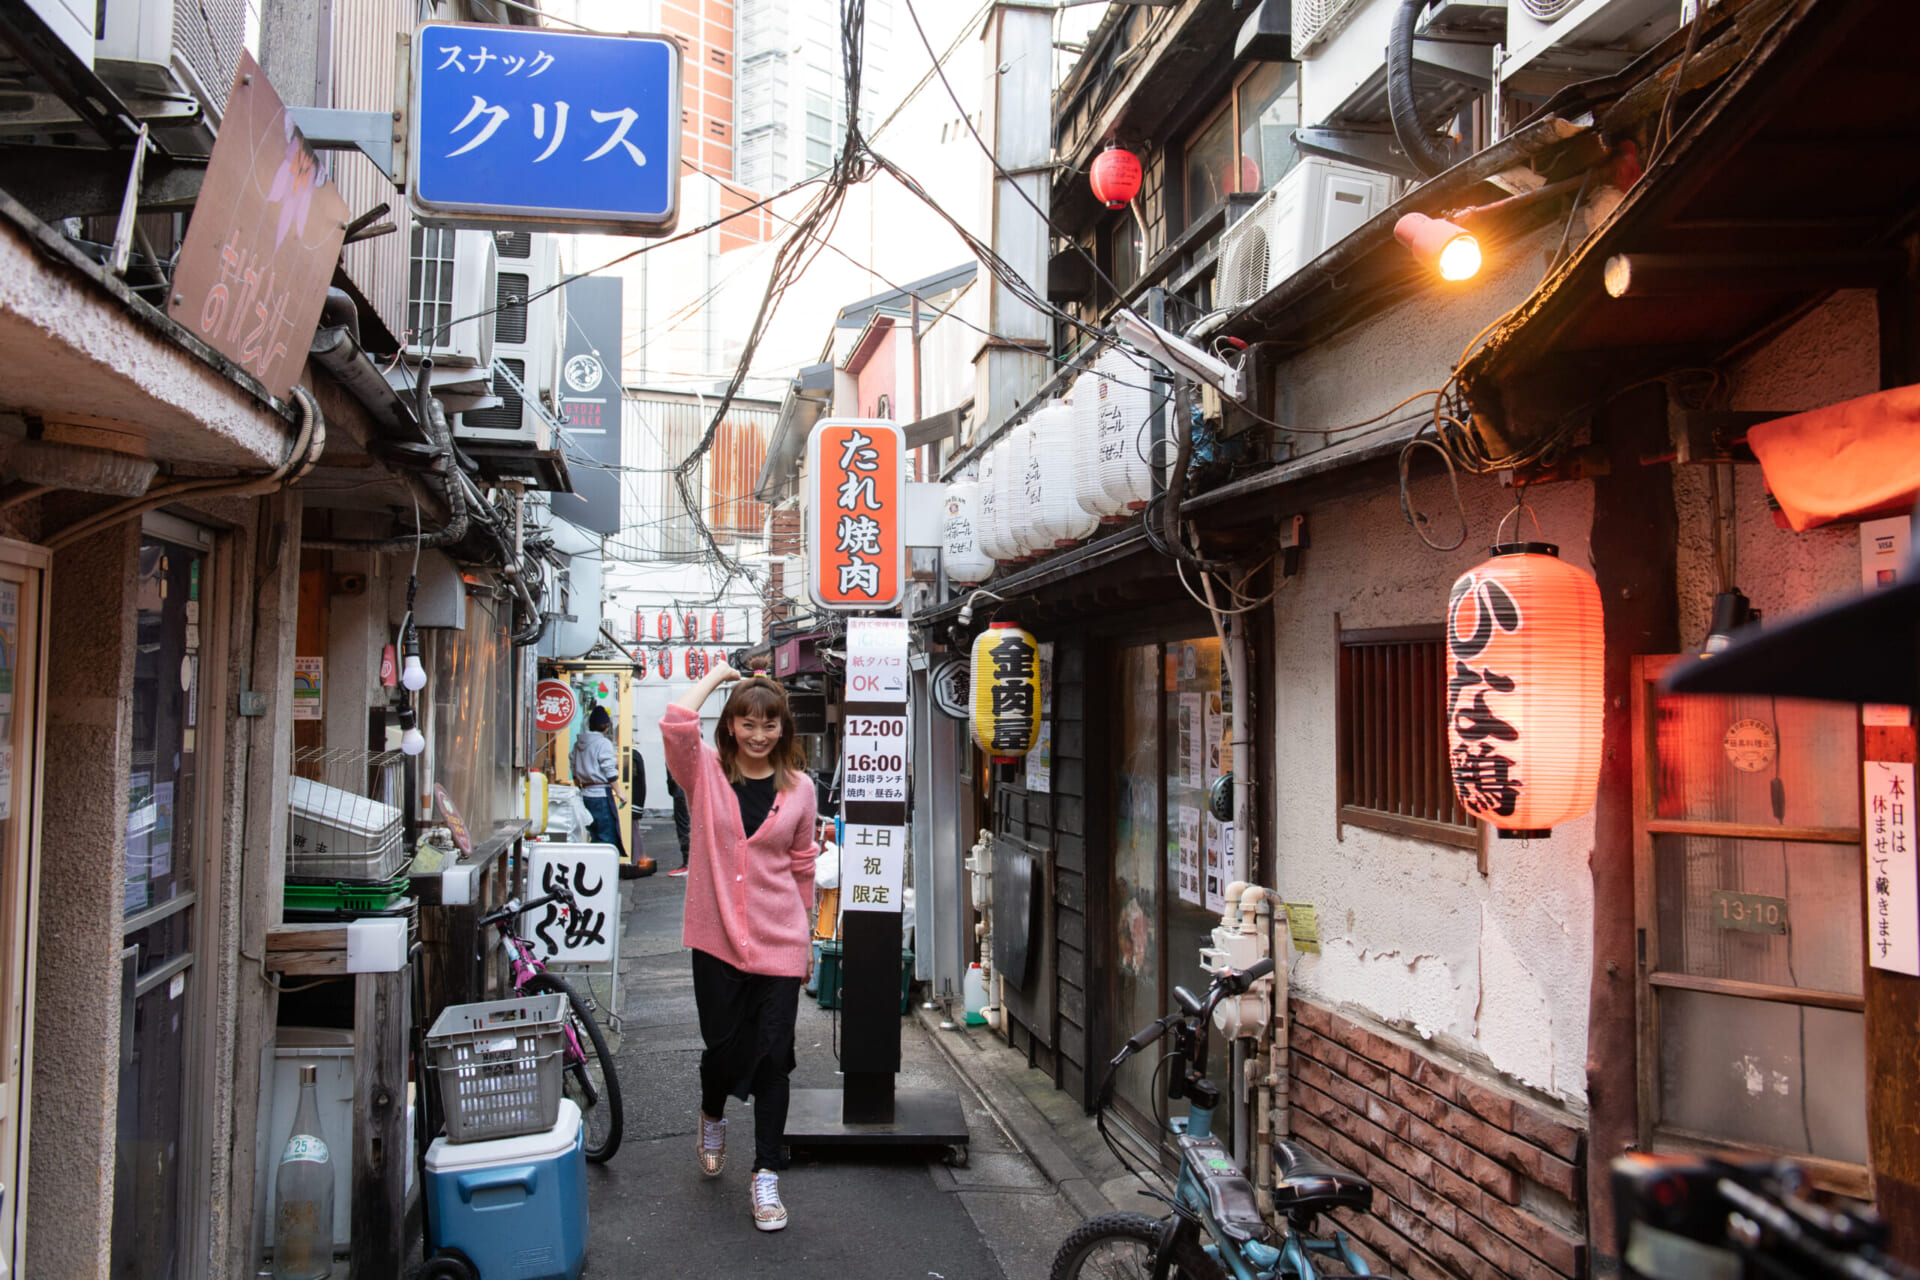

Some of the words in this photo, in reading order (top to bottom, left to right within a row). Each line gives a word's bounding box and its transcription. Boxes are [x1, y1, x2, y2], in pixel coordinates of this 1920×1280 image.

[436, 46, 555, 78] スナック
[444, 95, 647, 167] クリス
[565, 403, 601, 415] GYOZA
[836, 429, 883, 597] たれ焼肉
[1878, 541, 1893, 550] VISA
[852, 656, 901, 668] 紙タバコ
[852, 675, 880, 691] OK
[849, 719, 904, 737] 12:00
[847, 754, 902, 772] 16:00
[847, 774, 903, 785] 超お得ランチ
[1888, 775, 1907, 854] 本日は
[856, 827, 891, 847] 土日
[863, 855, 882, 875] 祝
[852, 885, 890, 904] 限定
[1720, 898, 1779, 926] 13-10
[294, 1140, 308, 1153] 25
